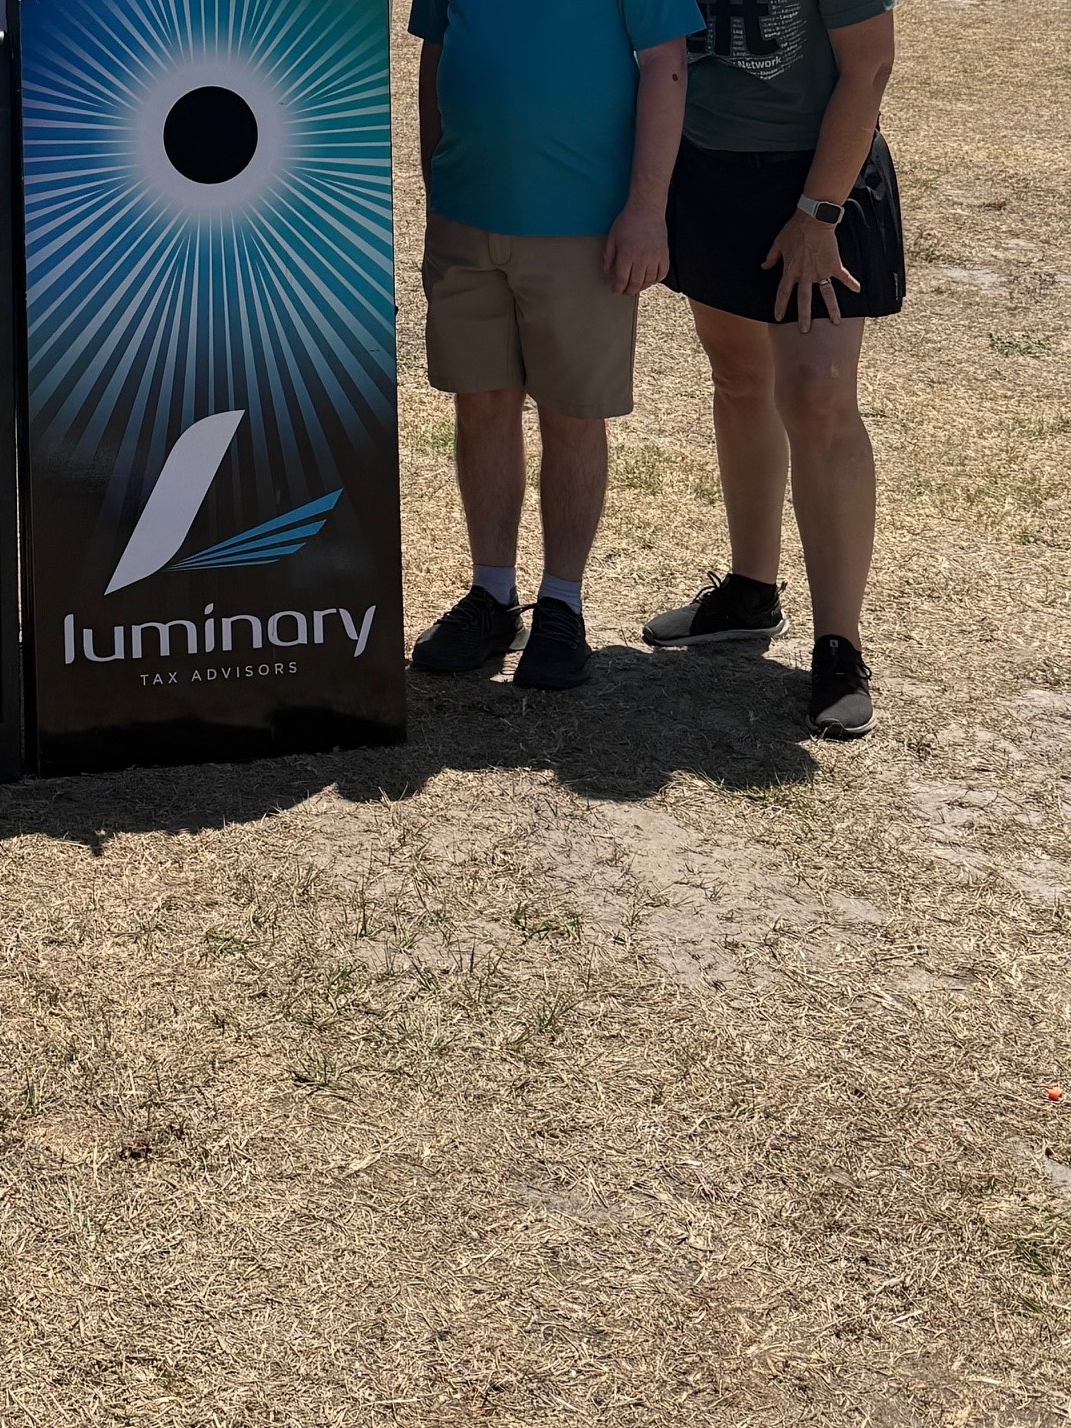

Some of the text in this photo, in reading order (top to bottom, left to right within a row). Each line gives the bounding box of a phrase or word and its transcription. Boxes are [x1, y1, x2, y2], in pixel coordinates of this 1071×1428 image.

[737, 56, 782, 69] Network
[62, 602, 377, 665] luminary
[140, 661, 298, 686] TAX ADVISORS
